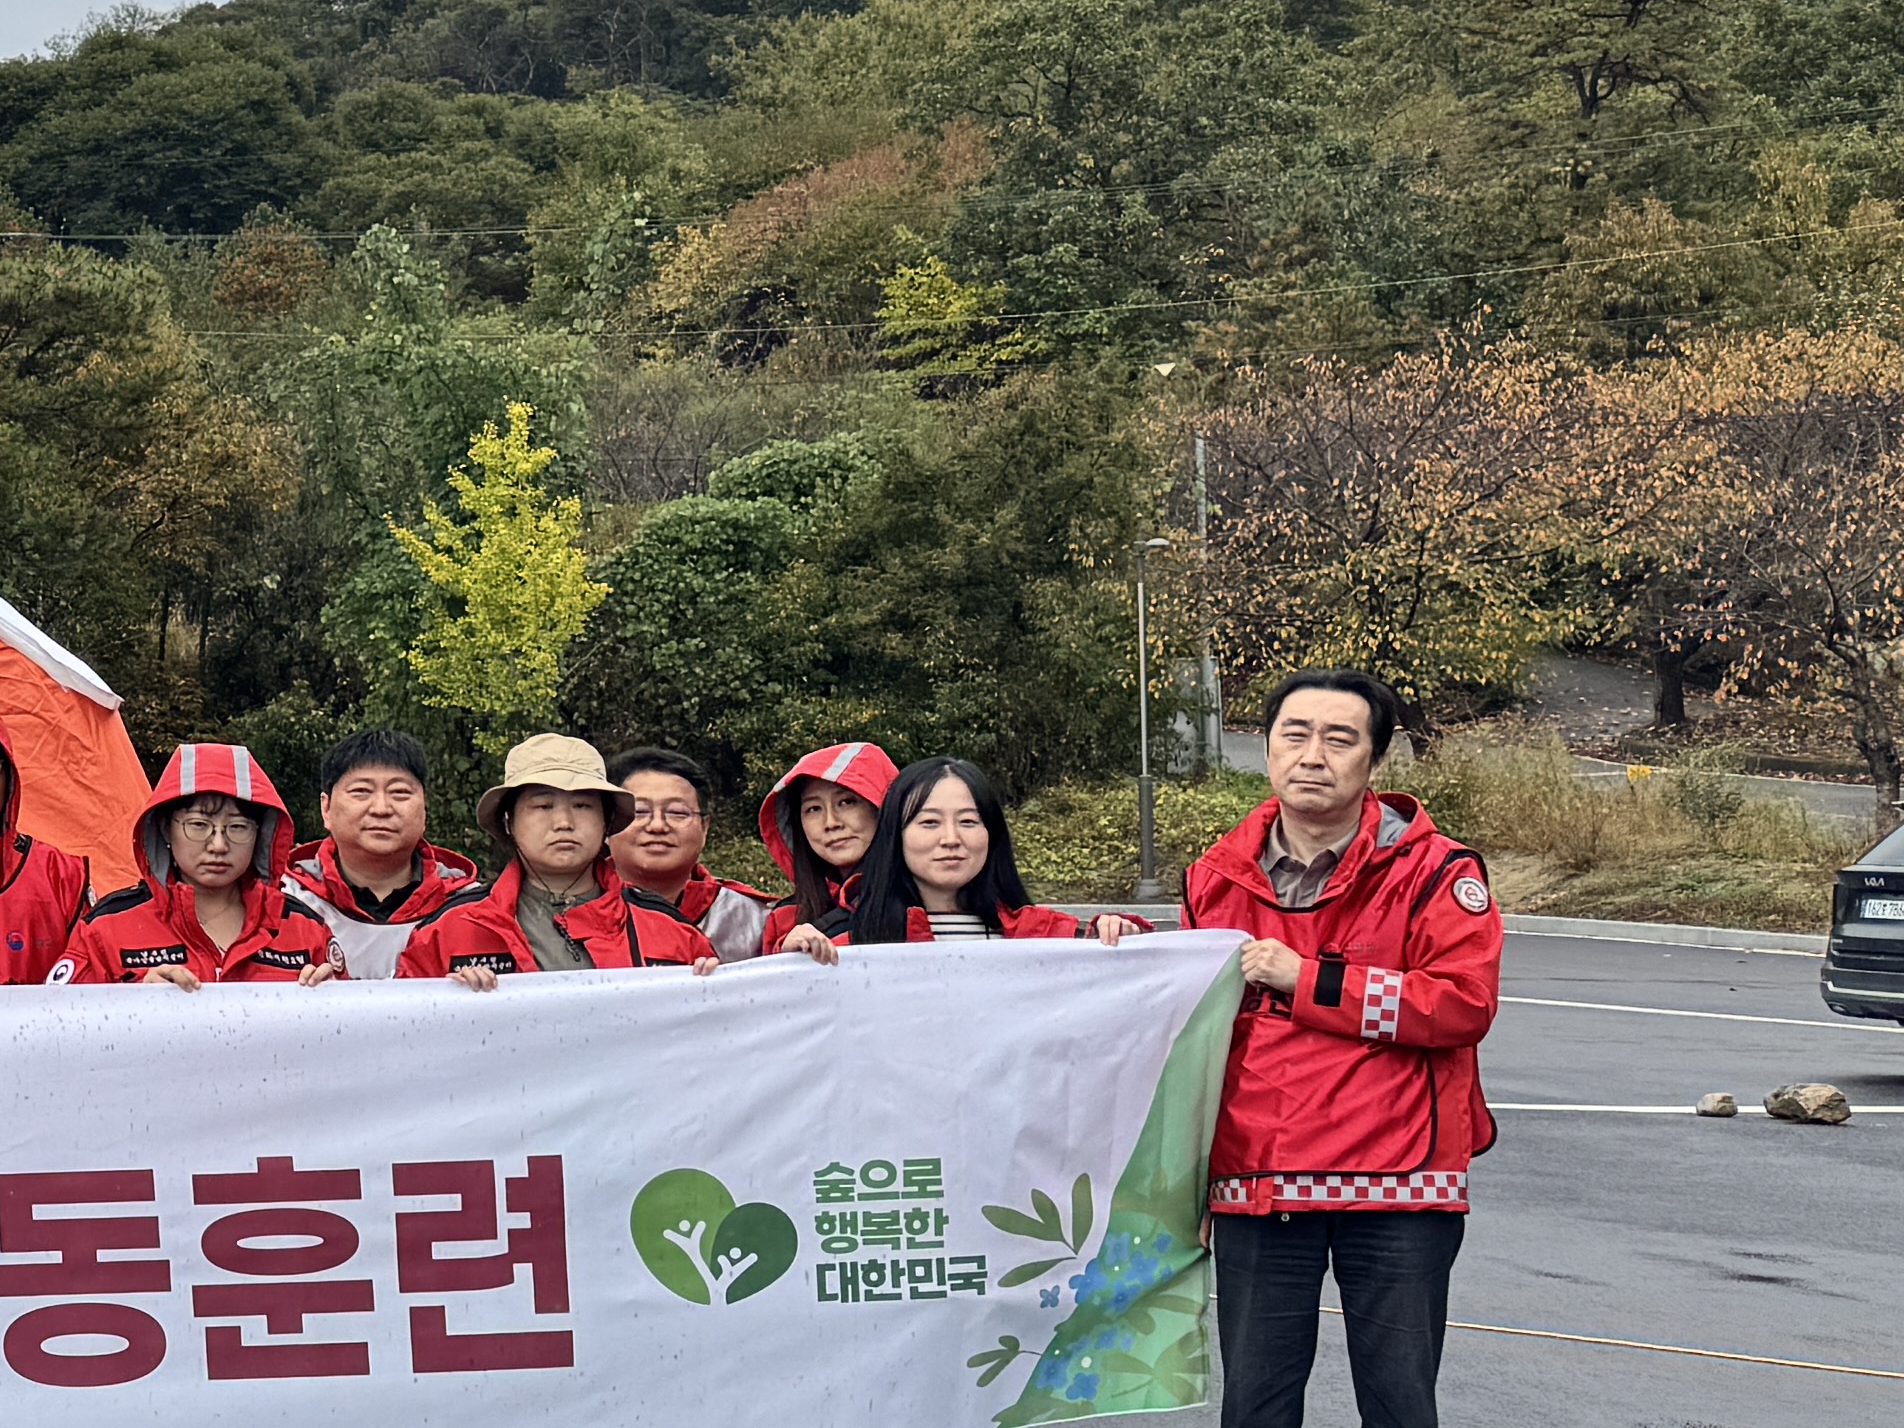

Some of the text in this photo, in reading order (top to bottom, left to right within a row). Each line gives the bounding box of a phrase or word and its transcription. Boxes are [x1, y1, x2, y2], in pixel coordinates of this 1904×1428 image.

[813, 1158, 944, 1203] 숲으로
[814, 1207, 949, 1254] 행복한
[816, 1255, 988, 1303] 대한민국
